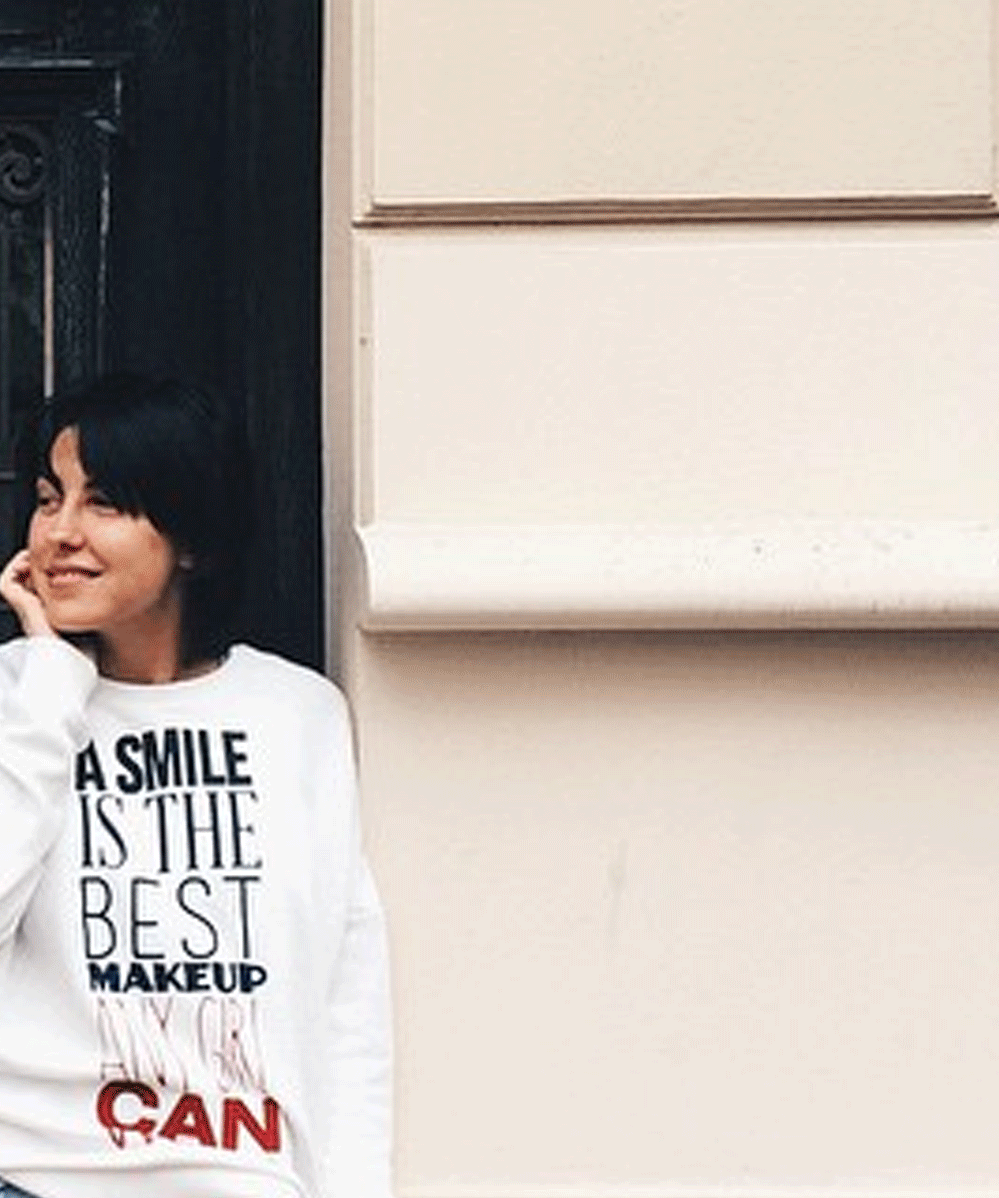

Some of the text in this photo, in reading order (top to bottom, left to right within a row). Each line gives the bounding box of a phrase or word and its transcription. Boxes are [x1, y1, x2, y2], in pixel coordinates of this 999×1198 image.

[75, 728, 253, 795] A SMILE
[78, 790, 264, 874] IS THE
[80, 876, 261, 960] BEST
[87, 962, 268, 994] MAKEUP
[96, 1078, 282, 1154] CAN
